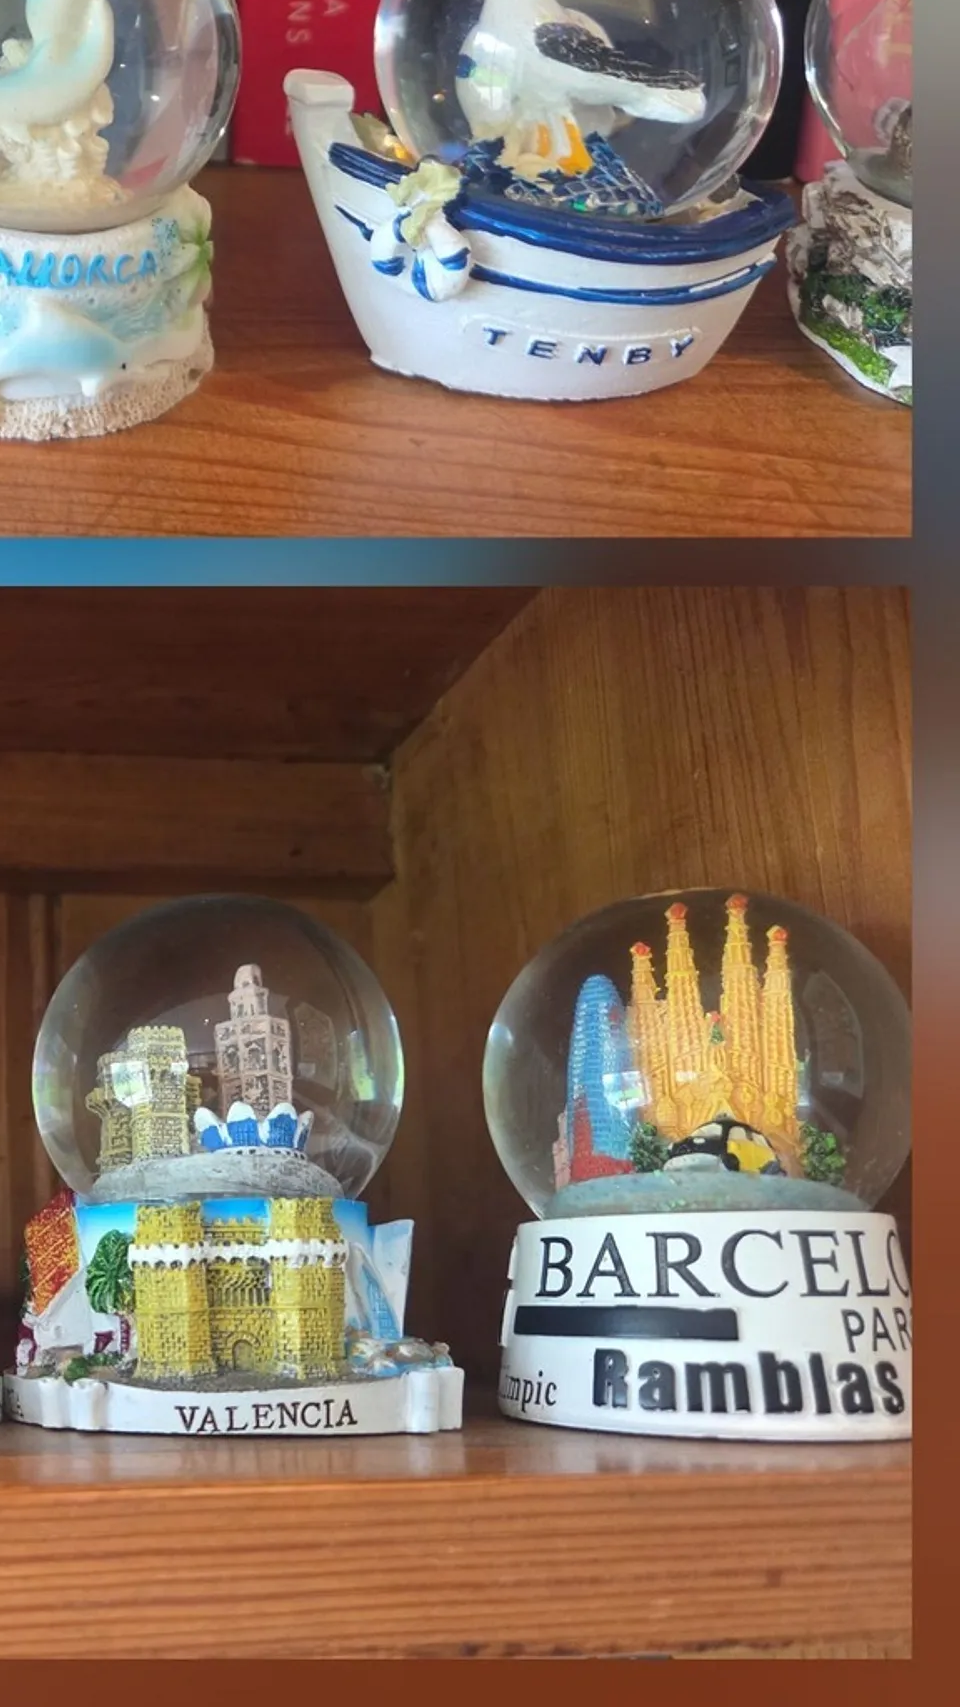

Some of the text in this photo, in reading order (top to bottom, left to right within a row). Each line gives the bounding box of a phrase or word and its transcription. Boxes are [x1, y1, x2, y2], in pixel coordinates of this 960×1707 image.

[482, 327, 695, 366] TENBY
[592, 1349, 905, 1416] Ramblas
[174, 1399, 358, 1434] VALENCIA
